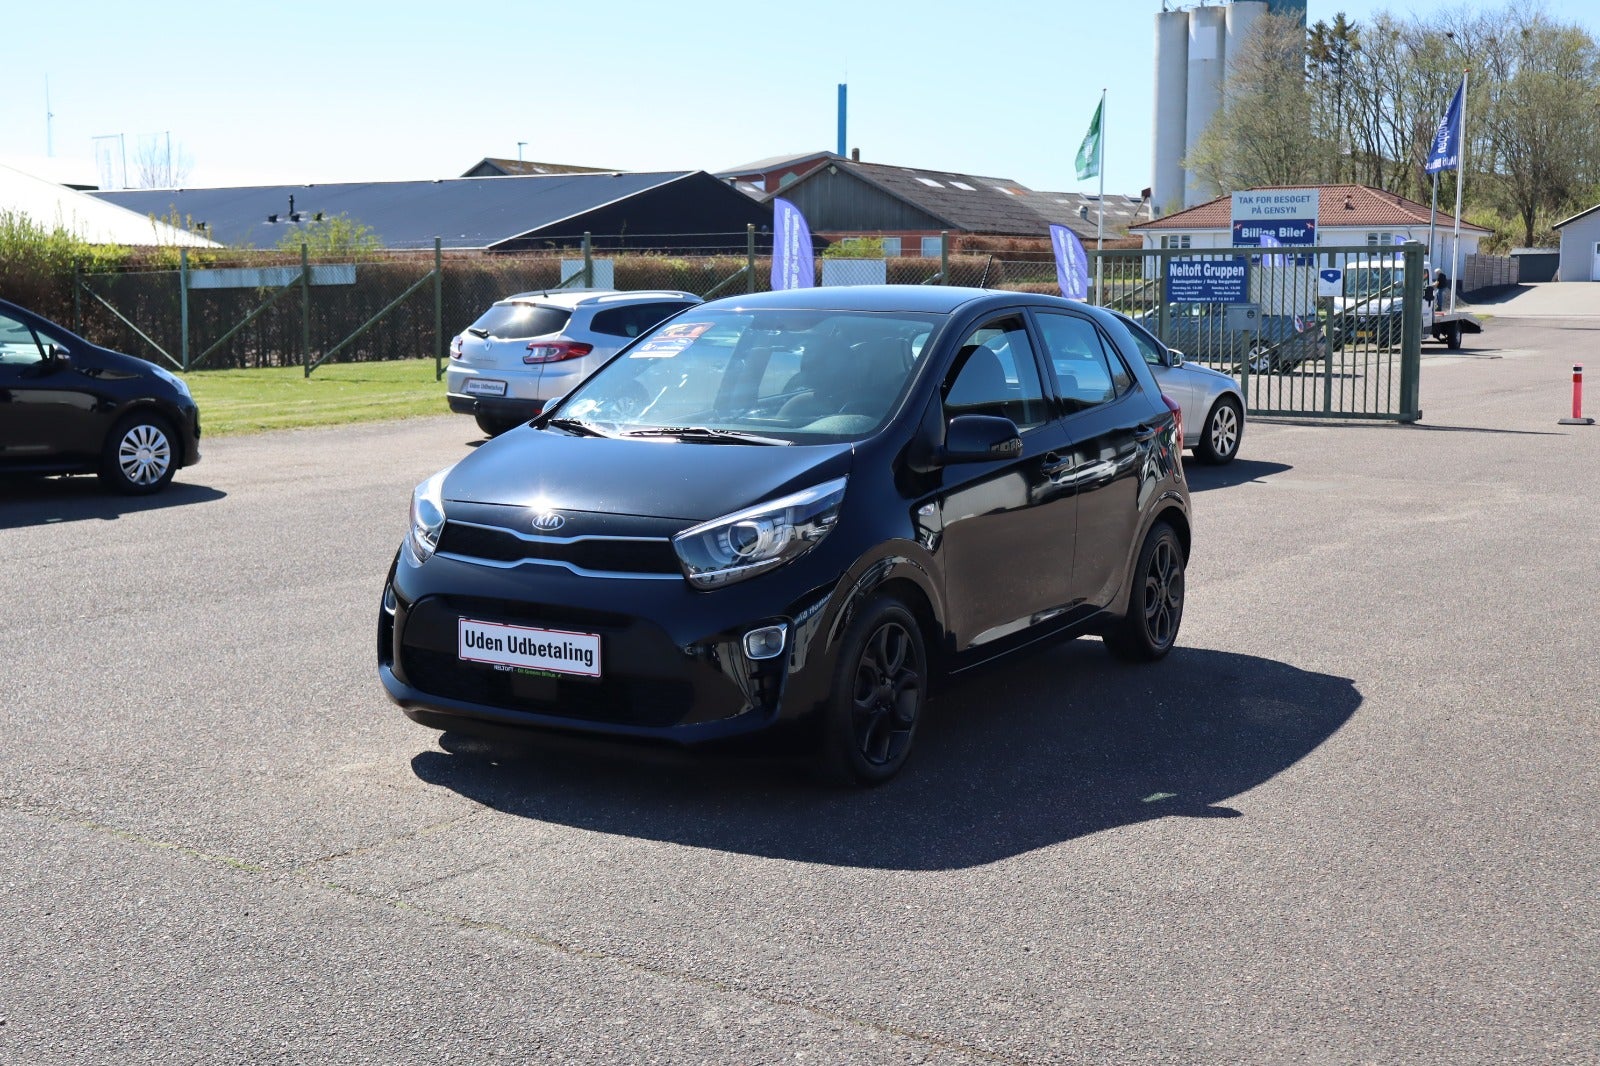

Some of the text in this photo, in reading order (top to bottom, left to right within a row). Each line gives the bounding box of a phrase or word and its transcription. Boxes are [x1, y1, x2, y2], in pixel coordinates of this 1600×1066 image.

[1239, 195, 1311, 204] TAK FOR BESØGET
[1251, 206, 1297, 214] PÅ GENSYN
[1278, 227, 1306, 238] Biler
[1170, 263, 1244, 279] Neltoft Gruppen
[535, 514, 559, 527] KIA
[465, 629, 593, 667] Uden Udbetaling
